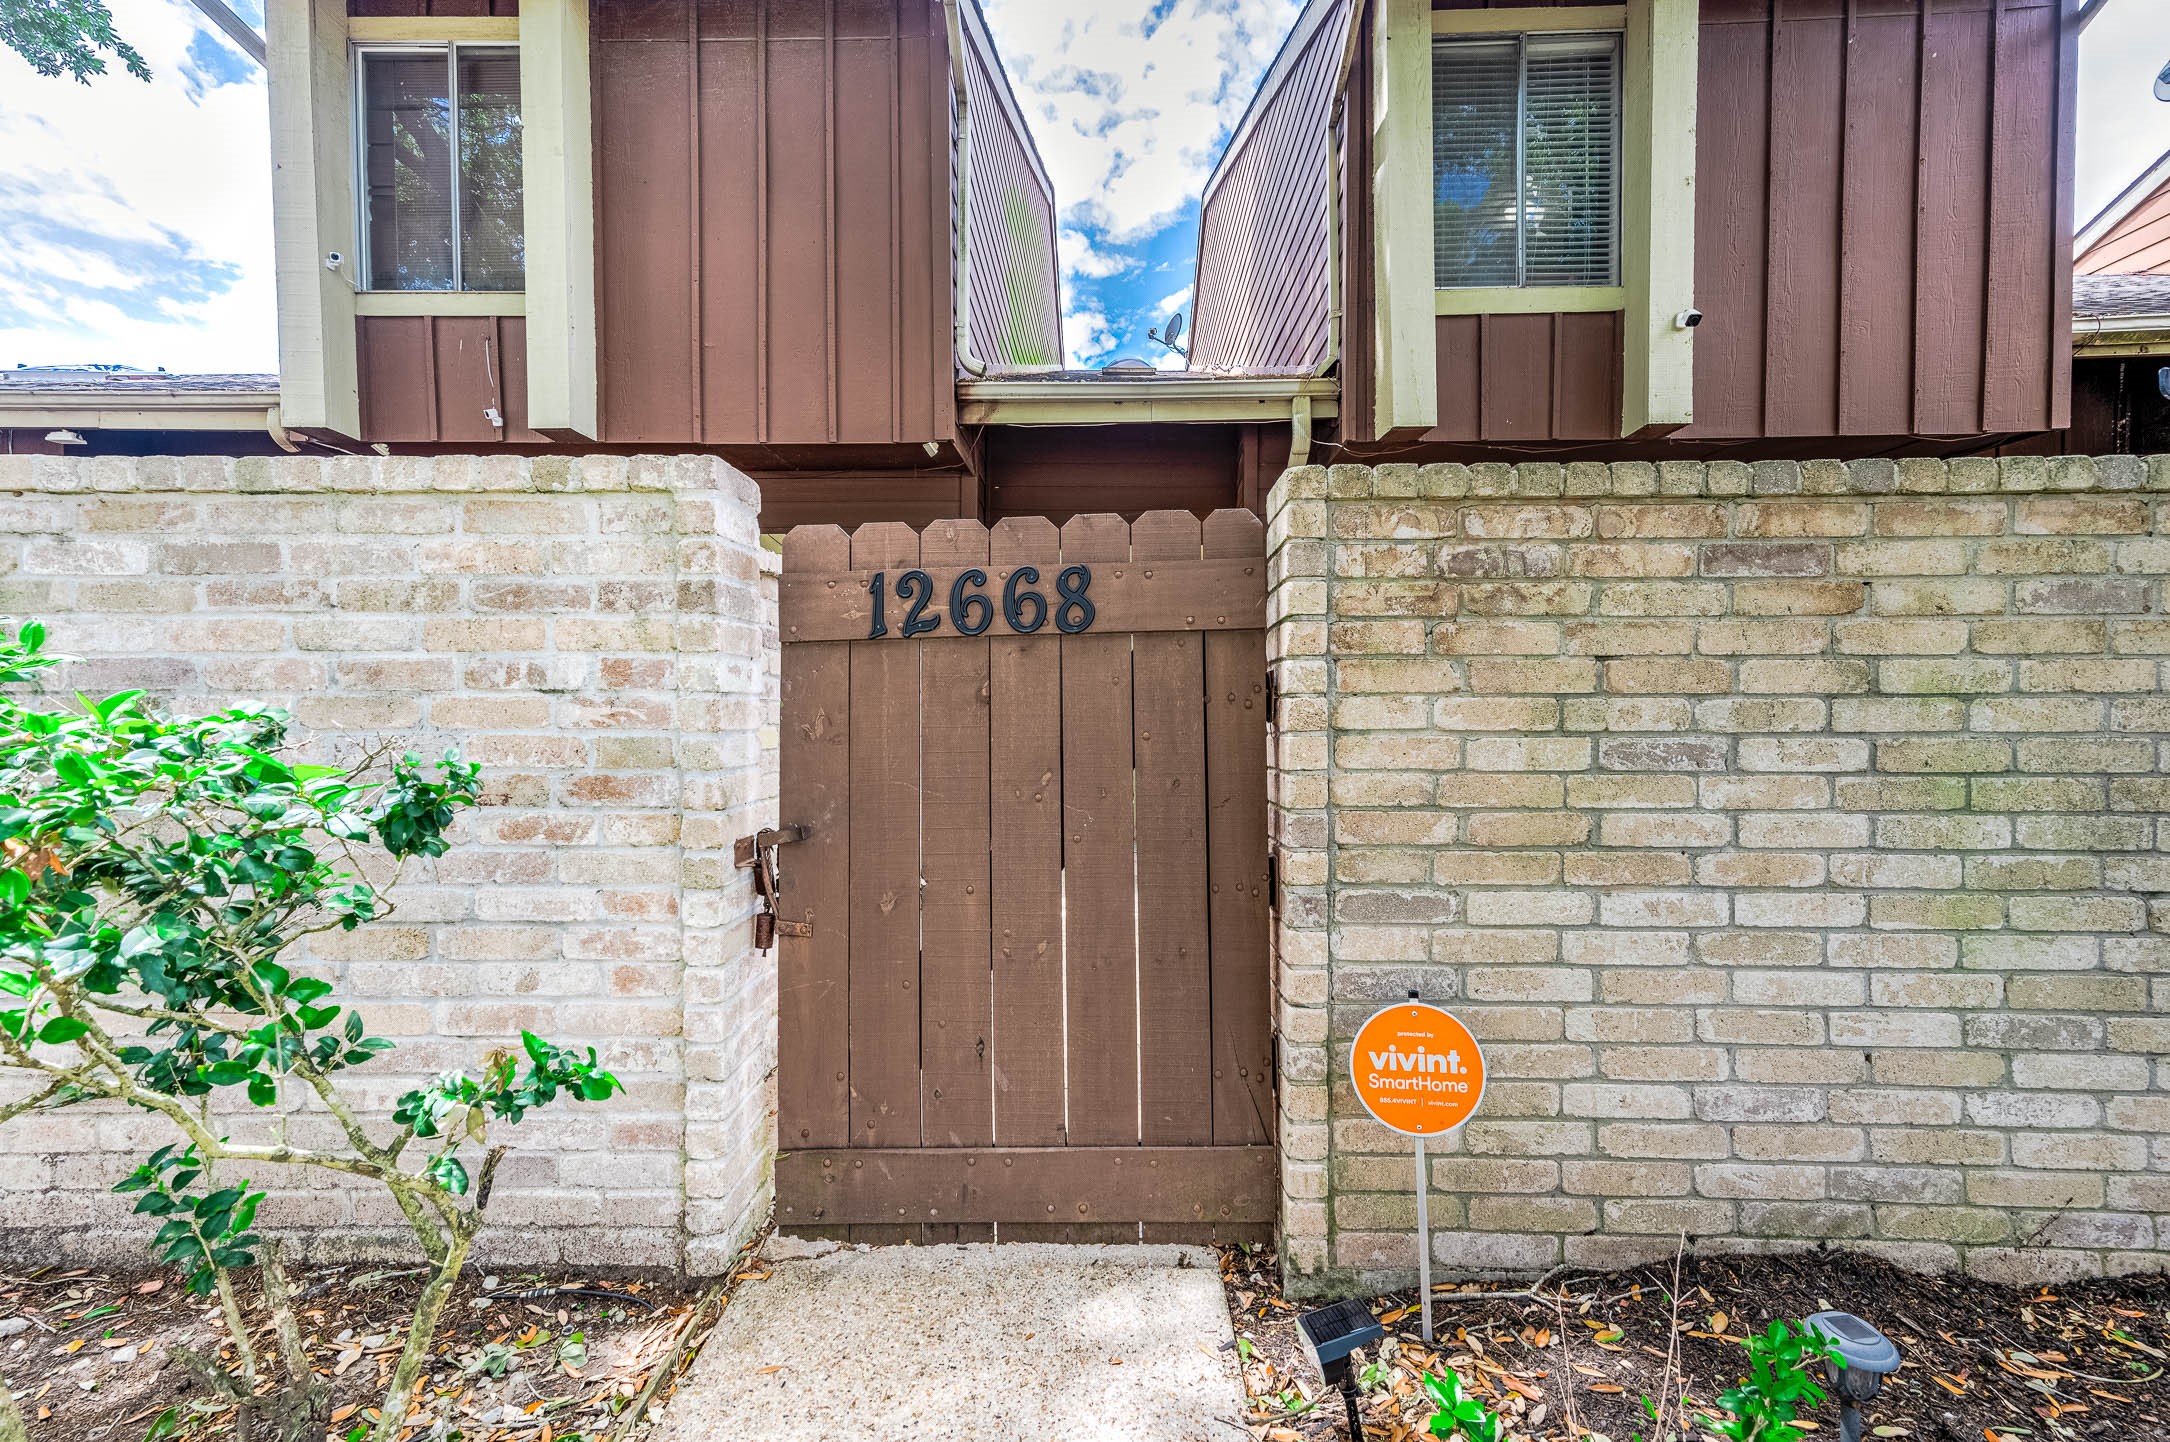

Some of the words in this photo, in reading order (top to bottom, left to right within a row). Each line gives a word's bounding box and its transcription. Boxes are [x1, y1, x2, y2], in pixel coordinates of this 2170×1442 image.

[869, 564, 1096, 640] 12668
[1368, 1044, 1468, 1075] vivint.
[1368, 1073, 1469, 1093] SmartHome
